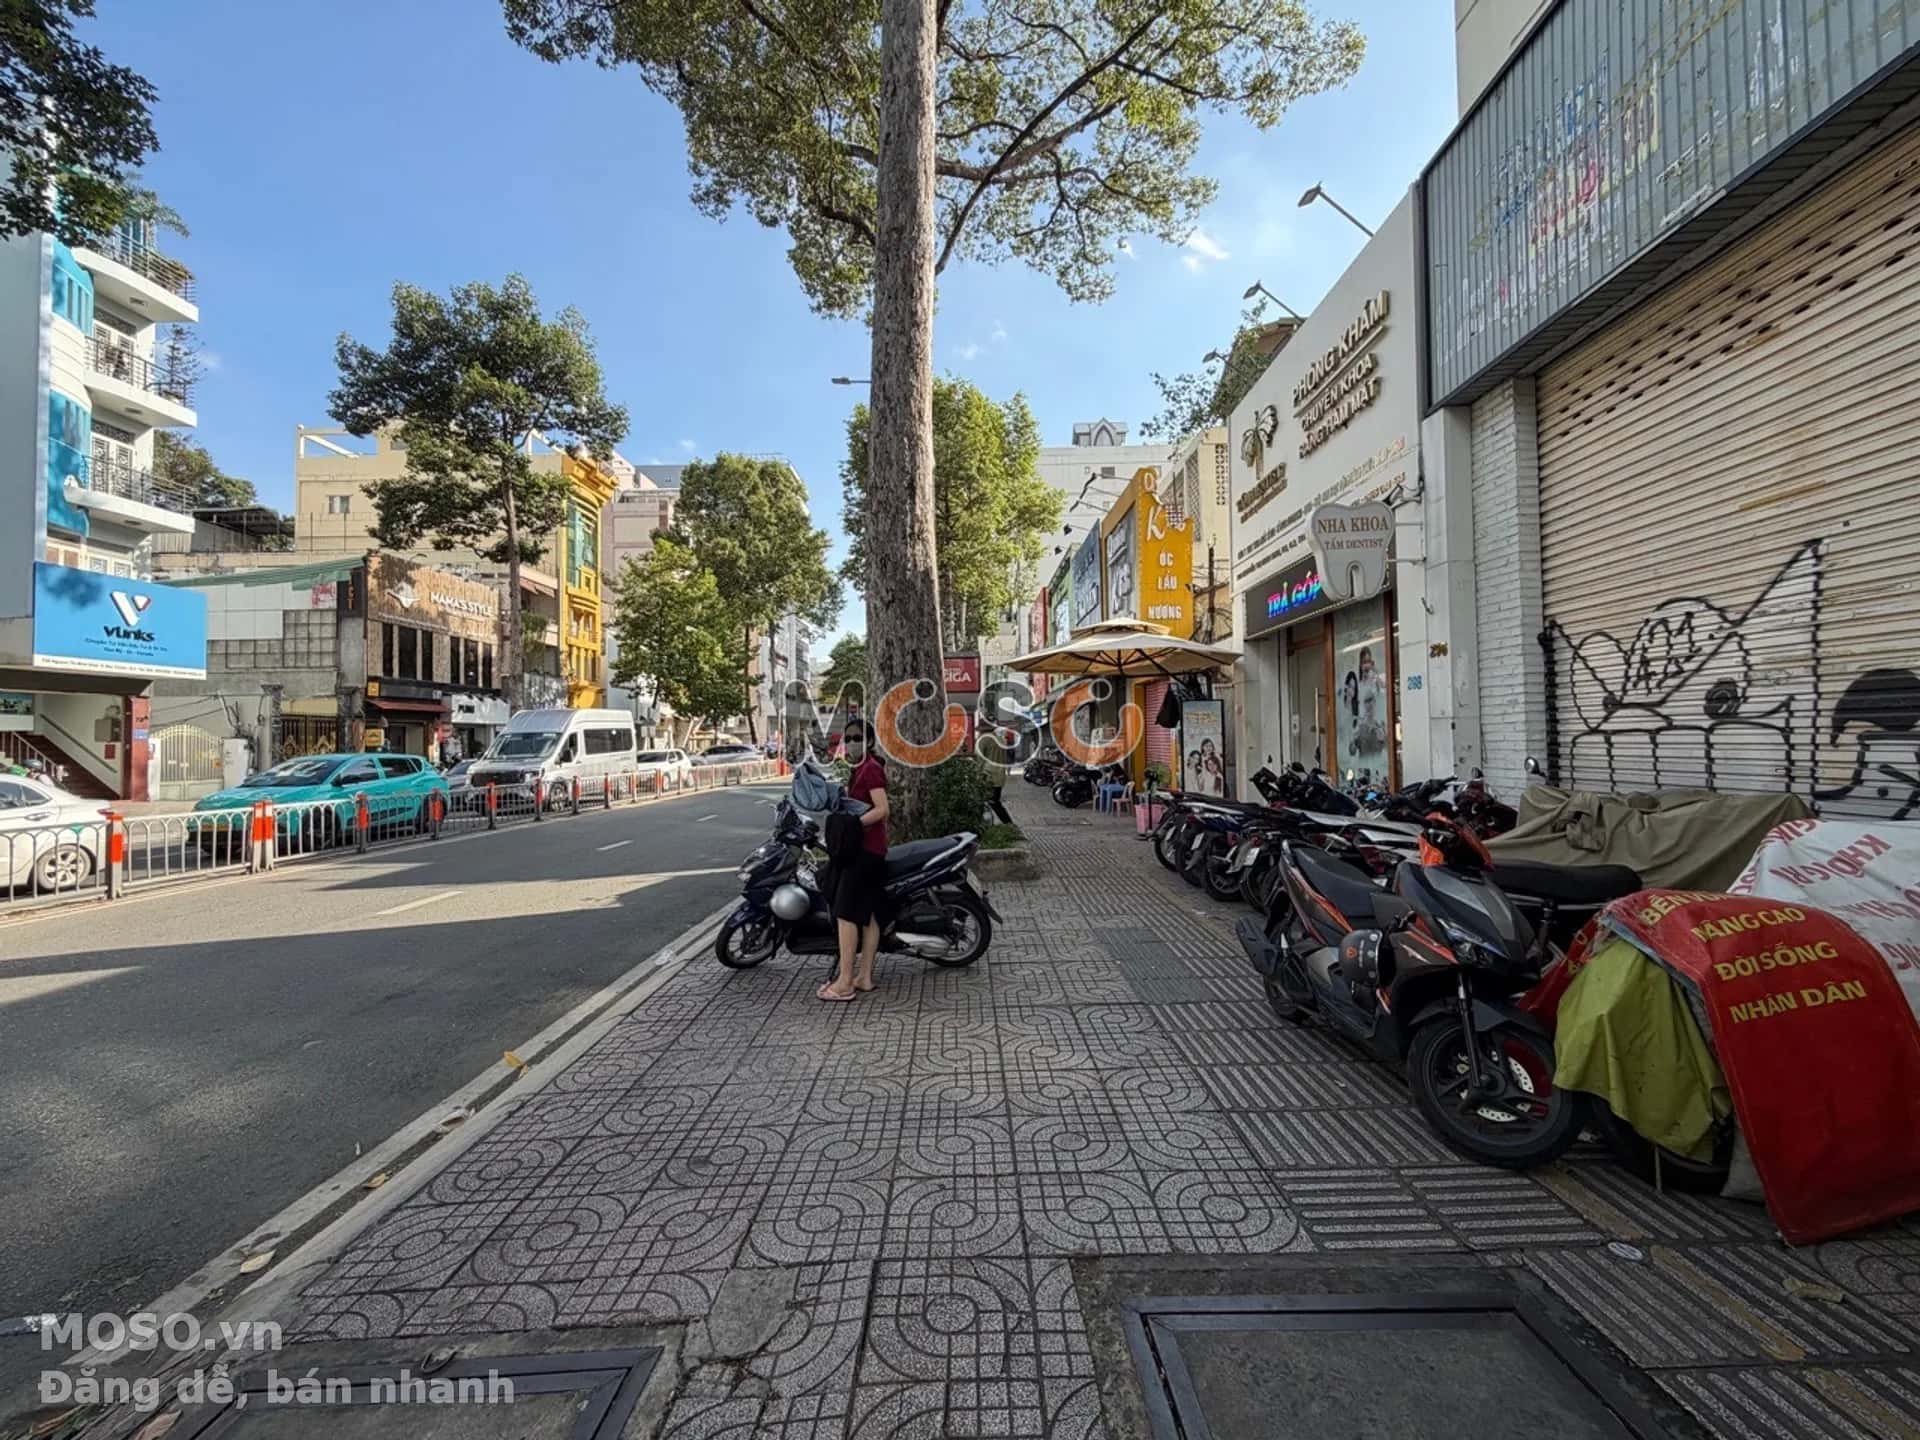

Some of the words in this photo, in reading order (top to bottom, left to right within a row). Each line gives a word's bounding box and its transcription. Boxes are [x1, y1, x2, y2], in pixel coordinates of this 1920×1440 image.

[1338, 288, 1389, 358] KHÁM
[1339, 353, 1377, 395] KHOA
[1318, 519, 1346, 533] NHA
[1351, 516, 1389, 532] KHOA
[1759, 907, 1806, 925] CAO
[1714, 955, 1760, 981] ĐỜI
[1760, 941, 1839, 970] SỐNG
[1729, 990, 1797, 1024] NHÂN
[1800, 980, 1867, 1008] DÂN
